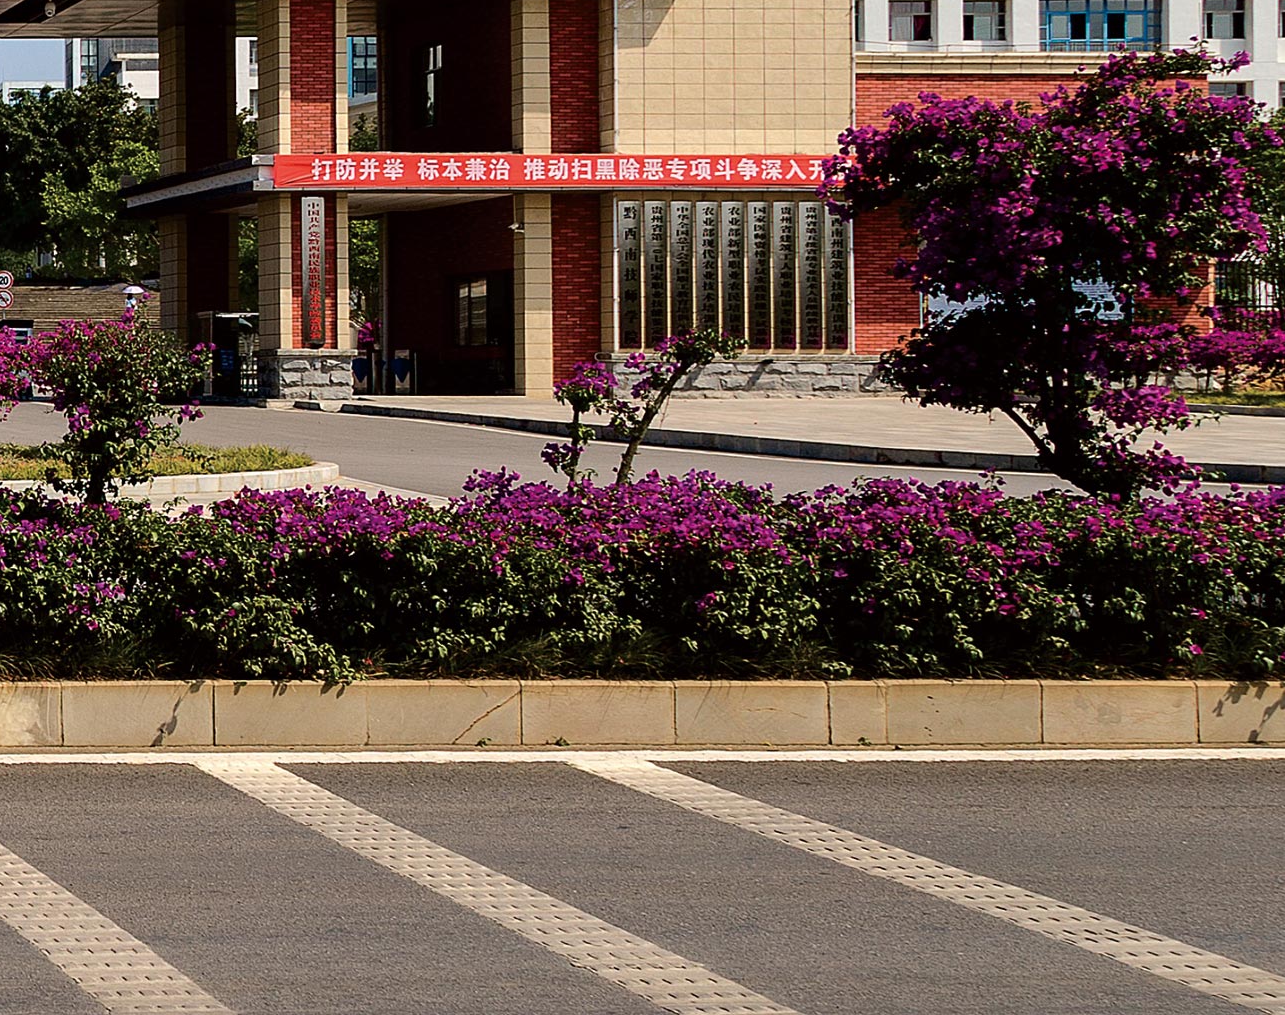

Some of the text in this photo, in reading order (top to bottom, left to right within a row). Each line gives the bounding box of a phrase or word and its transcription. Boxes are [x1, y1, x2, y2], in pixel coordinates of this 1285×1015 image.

[311, 157, 405, 182] 打防并举
[417, 157, 511, 182] 标本兼治
[623, 205, 638, 345] 黔西南技师学院
